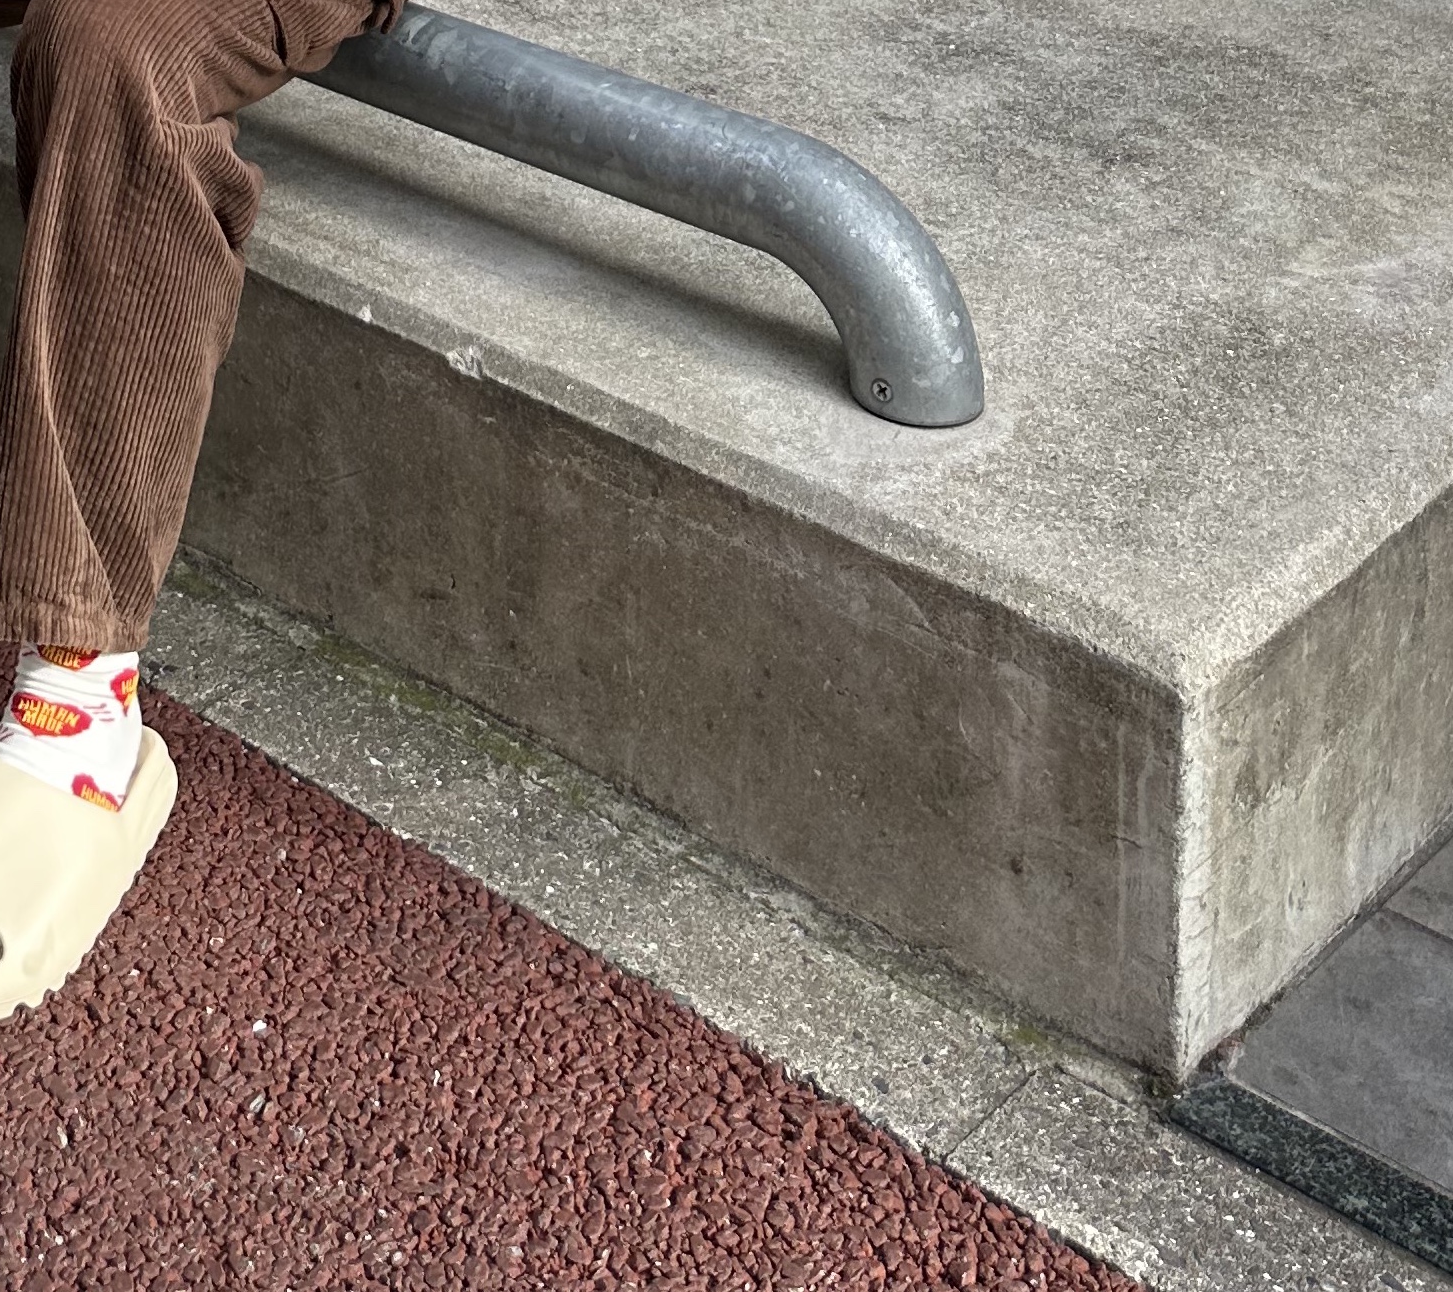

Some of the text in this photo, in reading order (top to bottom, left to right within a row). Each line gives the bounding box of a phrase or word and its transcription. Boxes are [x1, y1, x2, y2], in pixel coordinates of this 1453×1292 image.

[41, 646, 81, 669] MADE
[18, 699, 80, 728] HUMAN
[22, 710, 66, 735] MADE
